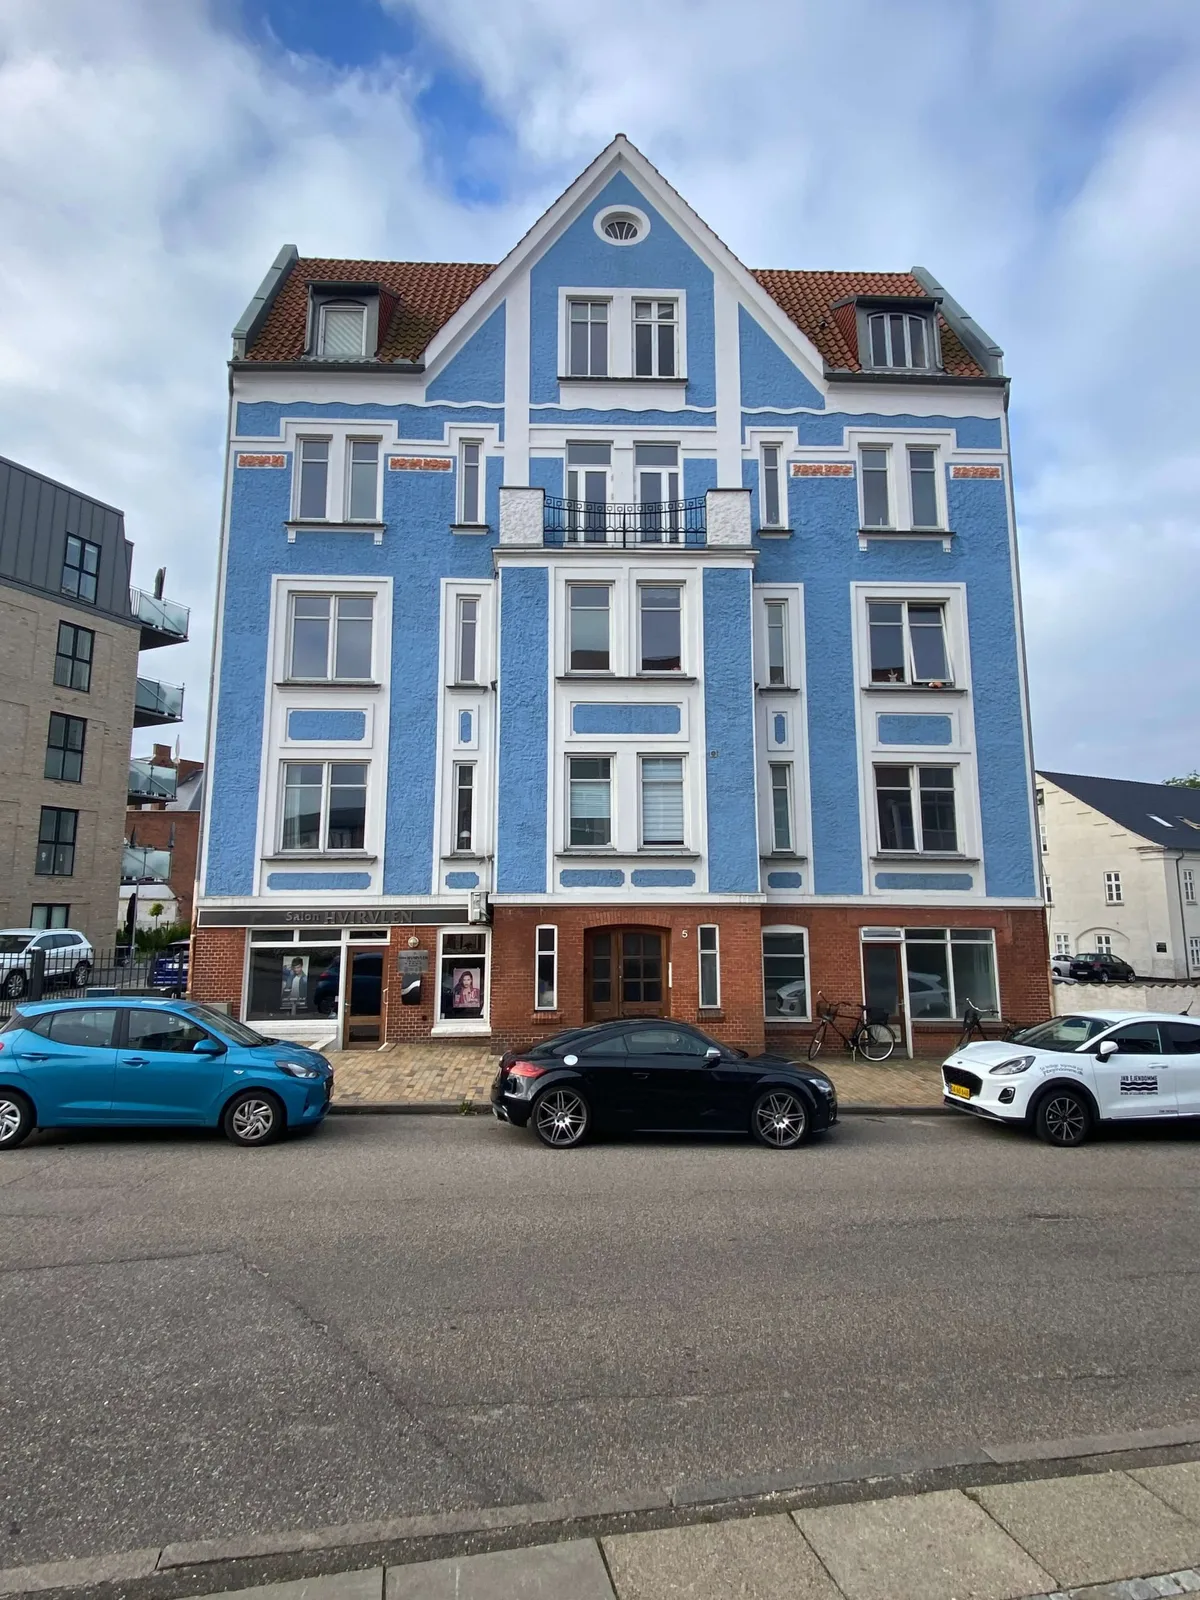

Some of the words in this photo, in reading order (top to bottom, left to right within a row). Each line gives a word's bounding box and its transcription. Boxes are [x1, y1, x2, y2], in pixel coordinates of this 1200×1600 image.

[286, 911, 319, 921] Salon
[324, 910, 412, 924] HVIRVLEN
[682, 929, 688, 938] 5
